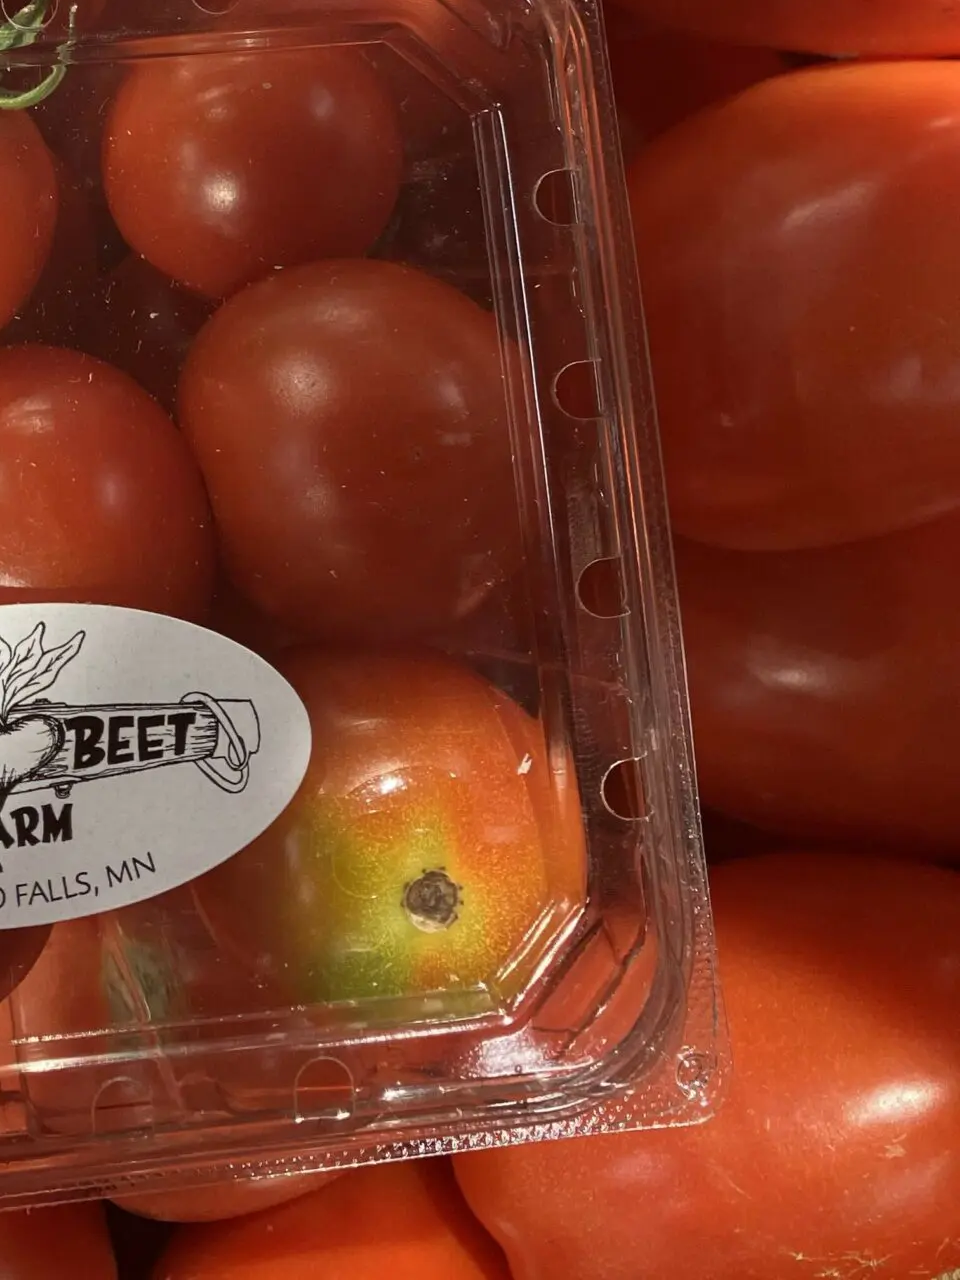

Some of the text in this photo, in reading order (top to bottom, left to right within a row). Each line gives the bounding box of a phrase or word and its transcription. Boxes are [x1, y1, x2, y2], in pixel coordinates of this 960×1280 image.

[65, 712, 197, 767] BEET
[16, 872, 100, 907] FALLS,
[106, 851, 157, 888] MN
